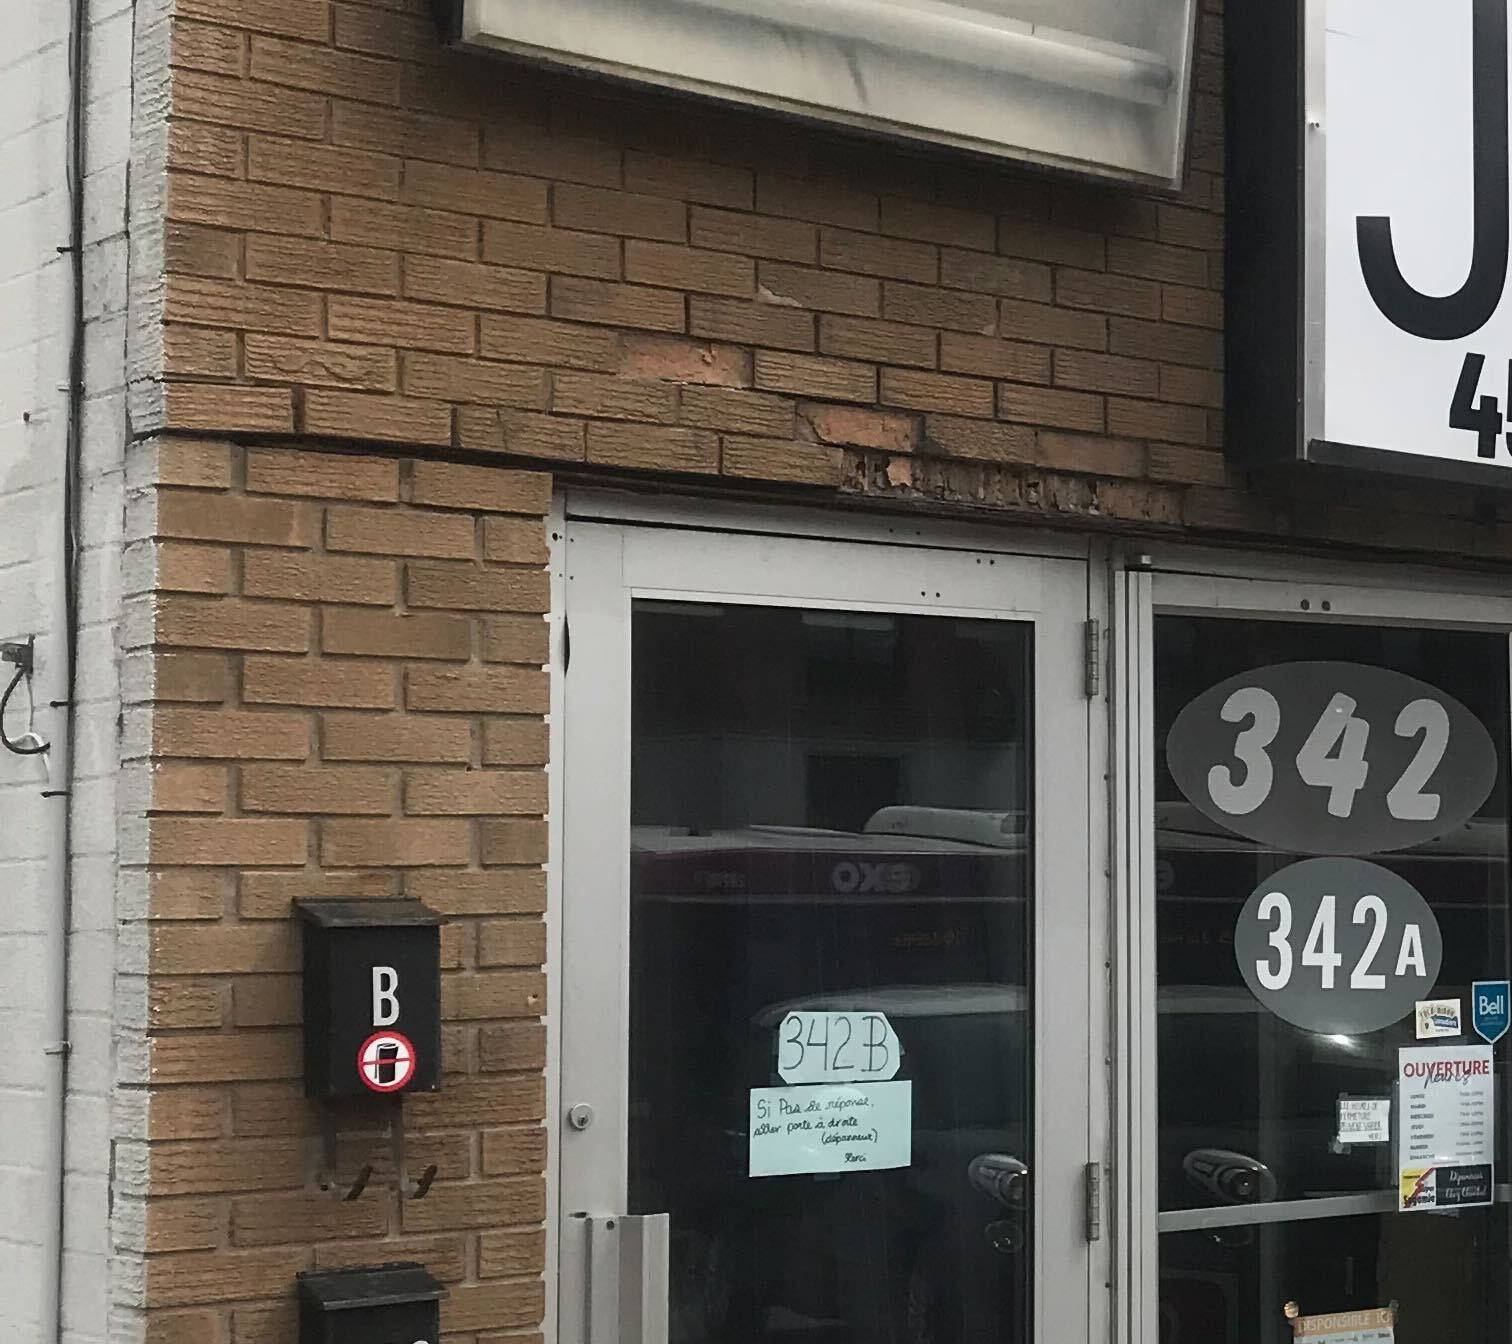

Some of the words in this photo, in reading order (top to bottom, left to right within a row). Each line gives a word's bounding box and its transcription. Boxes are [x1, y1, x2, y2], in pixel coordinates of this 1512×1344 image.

[1208, 687, 1450, 820] 342
[371, 965, 401, 1027] B
[1479, 995, 1504, 1015] Bell
[1403, 1060, 1490, 1077] OUVERTURE
[757, 1099, 770, 1119] Si
[804, 1100, 822, 1112] de
[753, 1123, 781, 1138] aller
[787, 1119, 812, 1135] porte
[815, 1117, 825, 1129] à
[828, 1116, 858, 1127] droite
